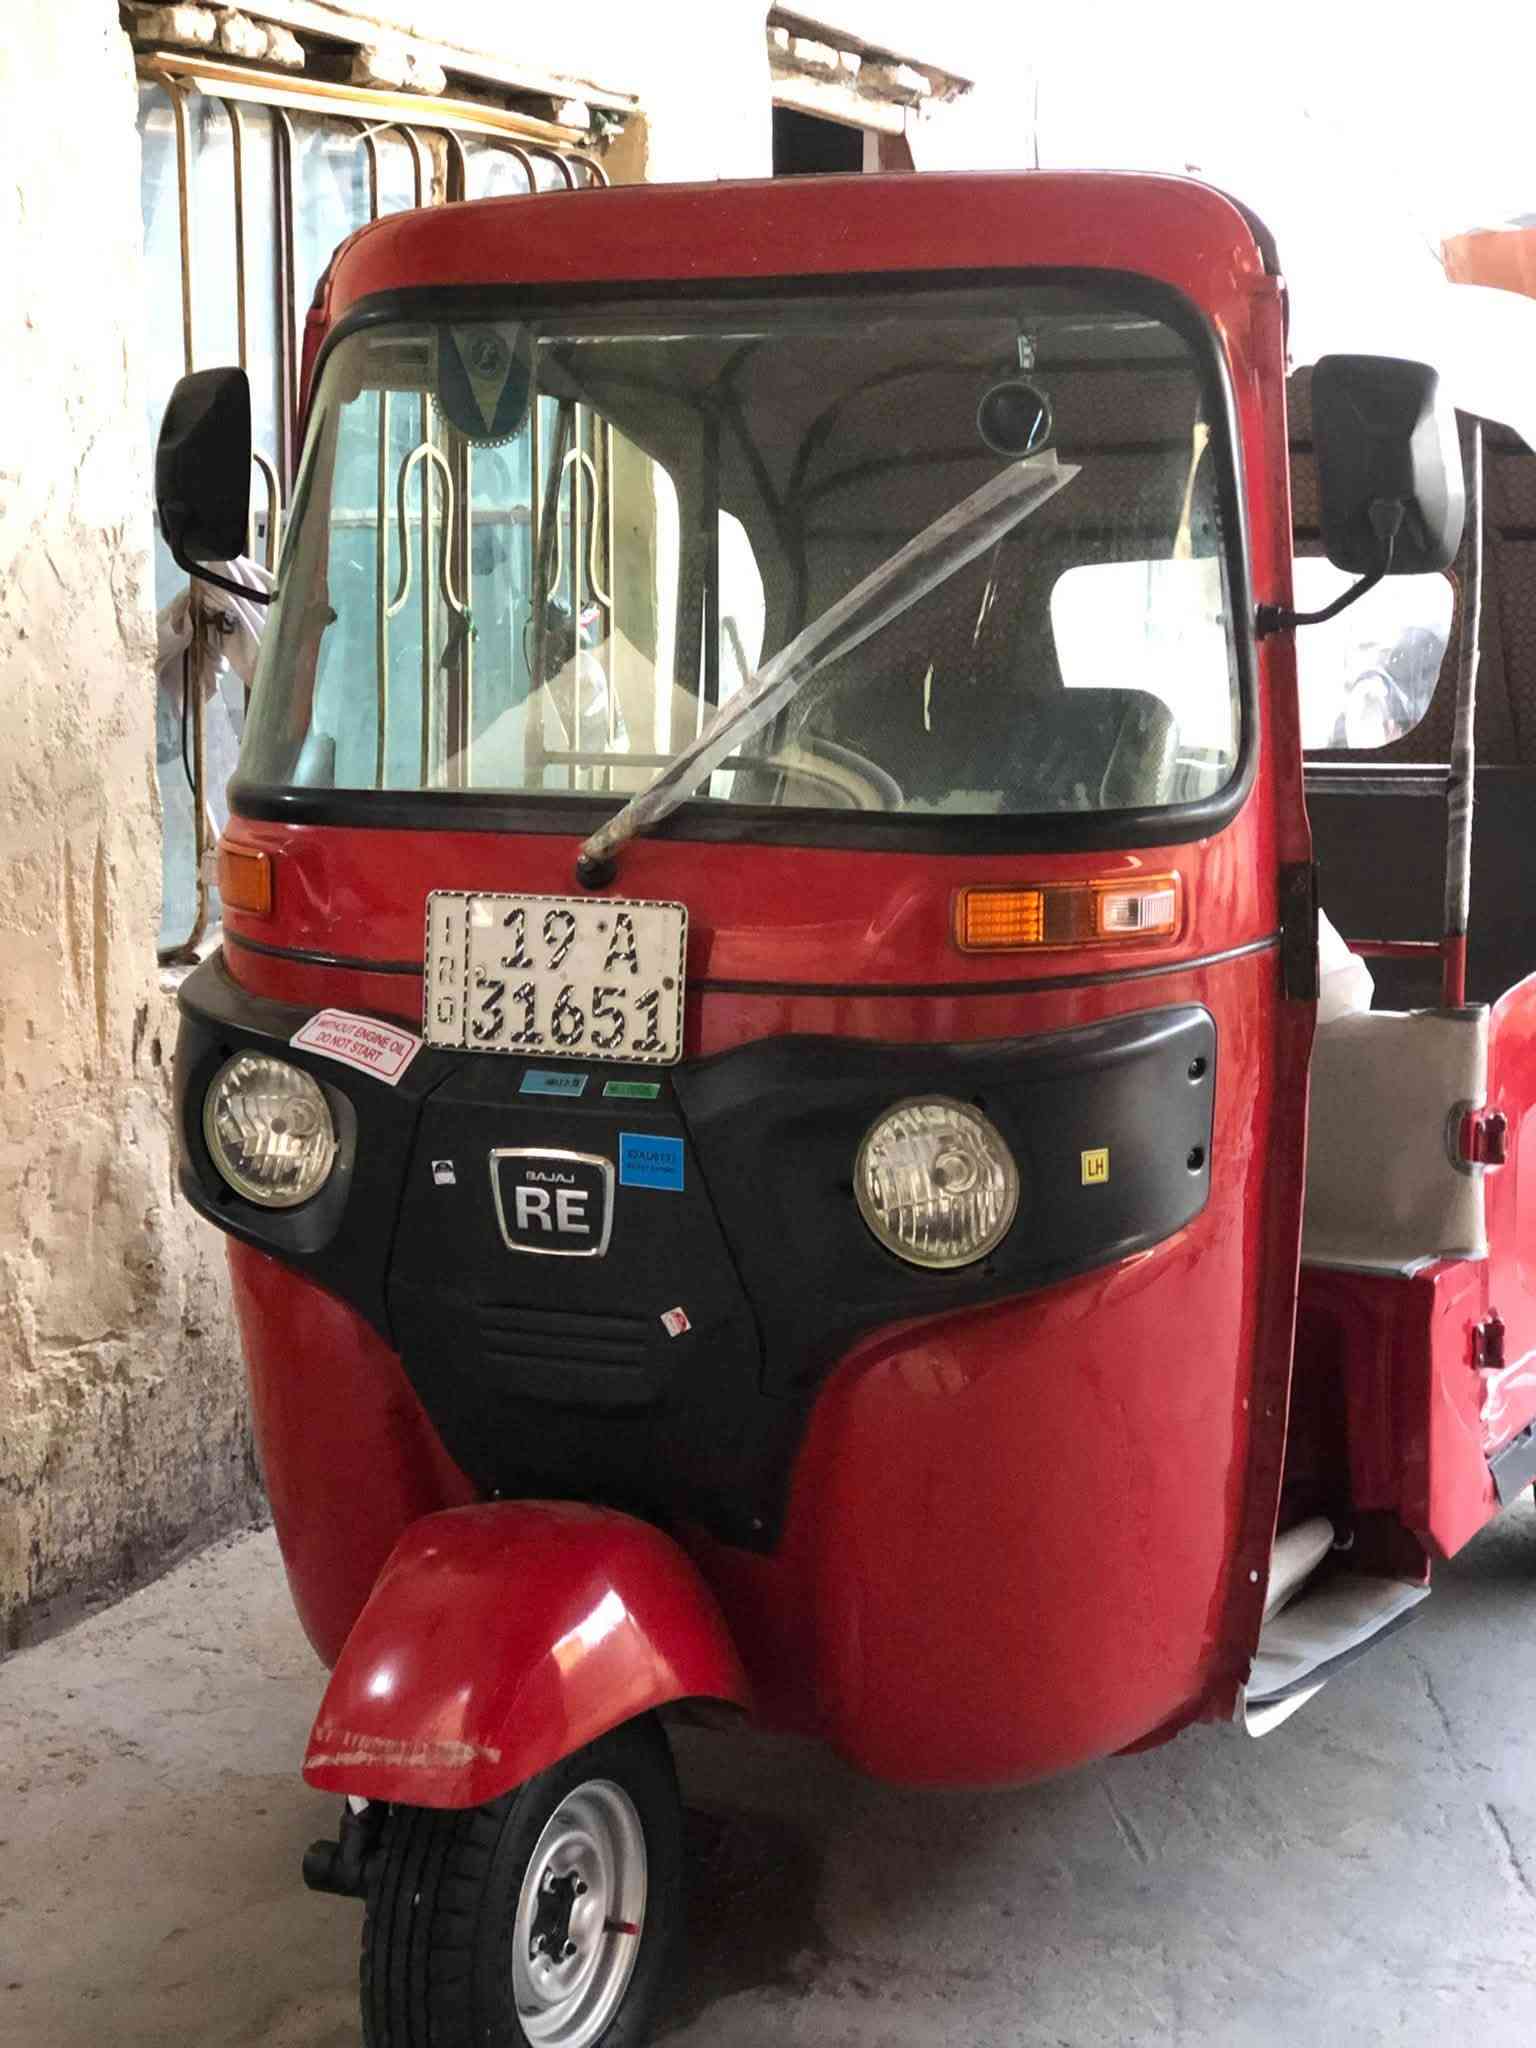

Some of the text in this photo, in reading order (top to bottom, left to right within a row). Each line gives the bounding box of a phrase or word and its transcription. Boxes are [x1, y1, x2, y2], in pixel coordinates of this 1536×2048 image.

[502, 908, 638, 974] 19 A
[471, 978, 667, 1053] 31651
[316, 1031, 384, 1062] DO NOT START
[354, 1025, 390, 1049] ENGINE
[390, 1041, 404, 1056] OIL
[526, 1170, 575, 1184] BAJAJ
[1088, 1157, 1104, 1177] LH
[515, 1185, 590, 1234] RE
